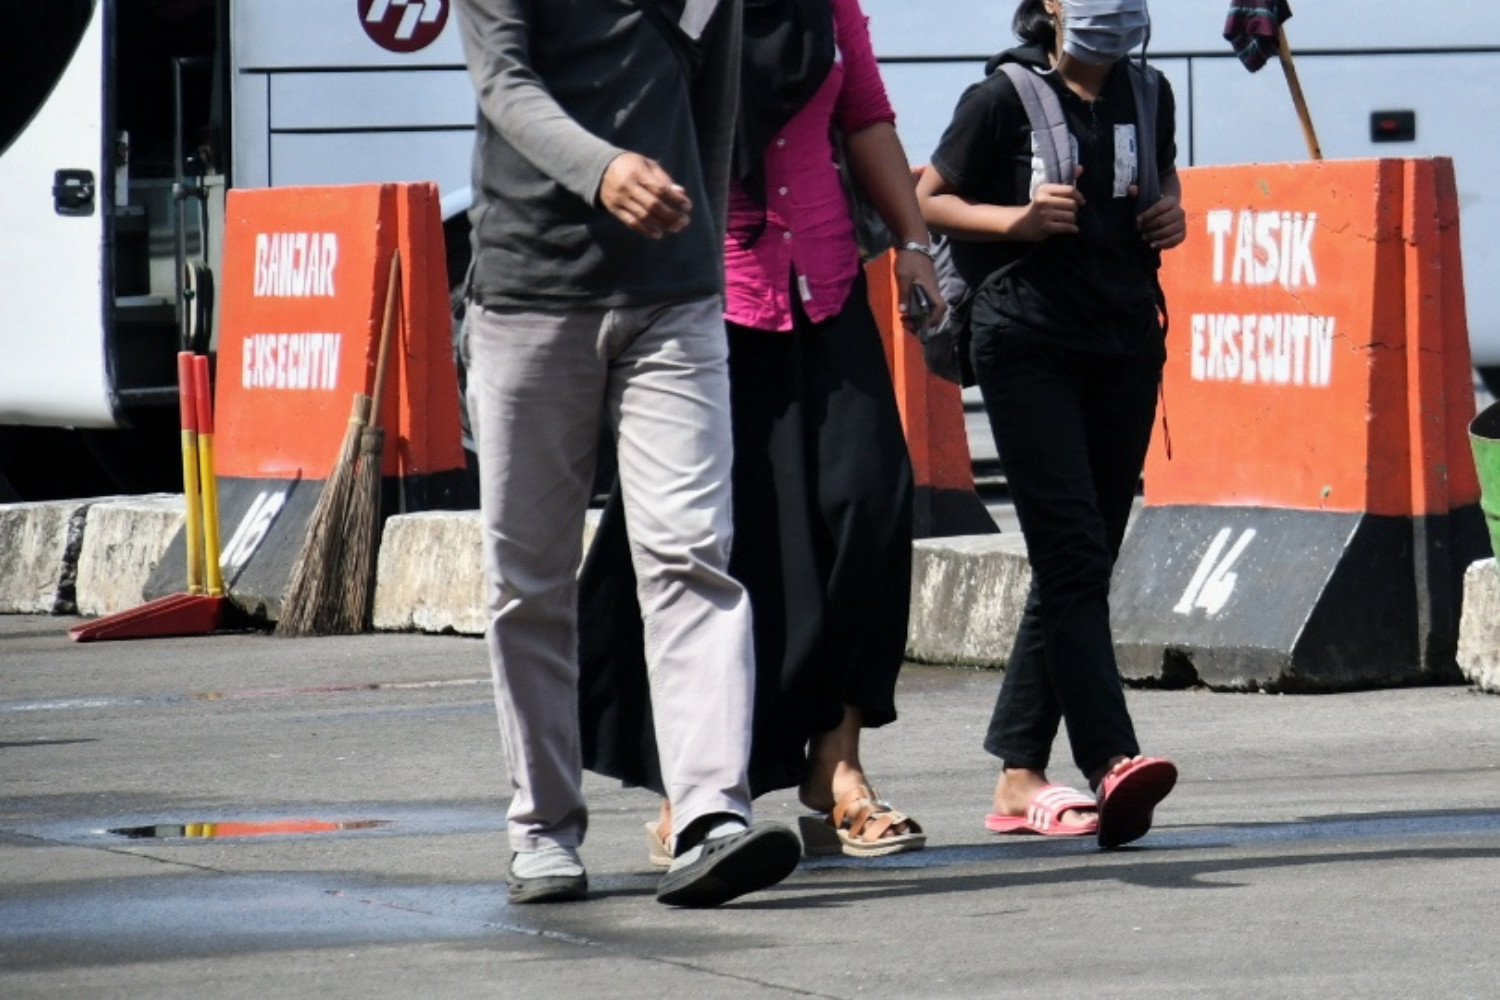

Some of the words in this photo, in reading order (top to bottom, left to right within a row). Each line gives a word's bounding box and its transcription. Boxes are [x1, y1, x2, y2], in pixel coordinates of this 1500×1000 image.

[254, 232, 337, 297] BANJAR
[1207, 210, 1317, 288] TASIK
[218, 491, 286, 568] 16
[1172, 527, 1257, 617] 14
